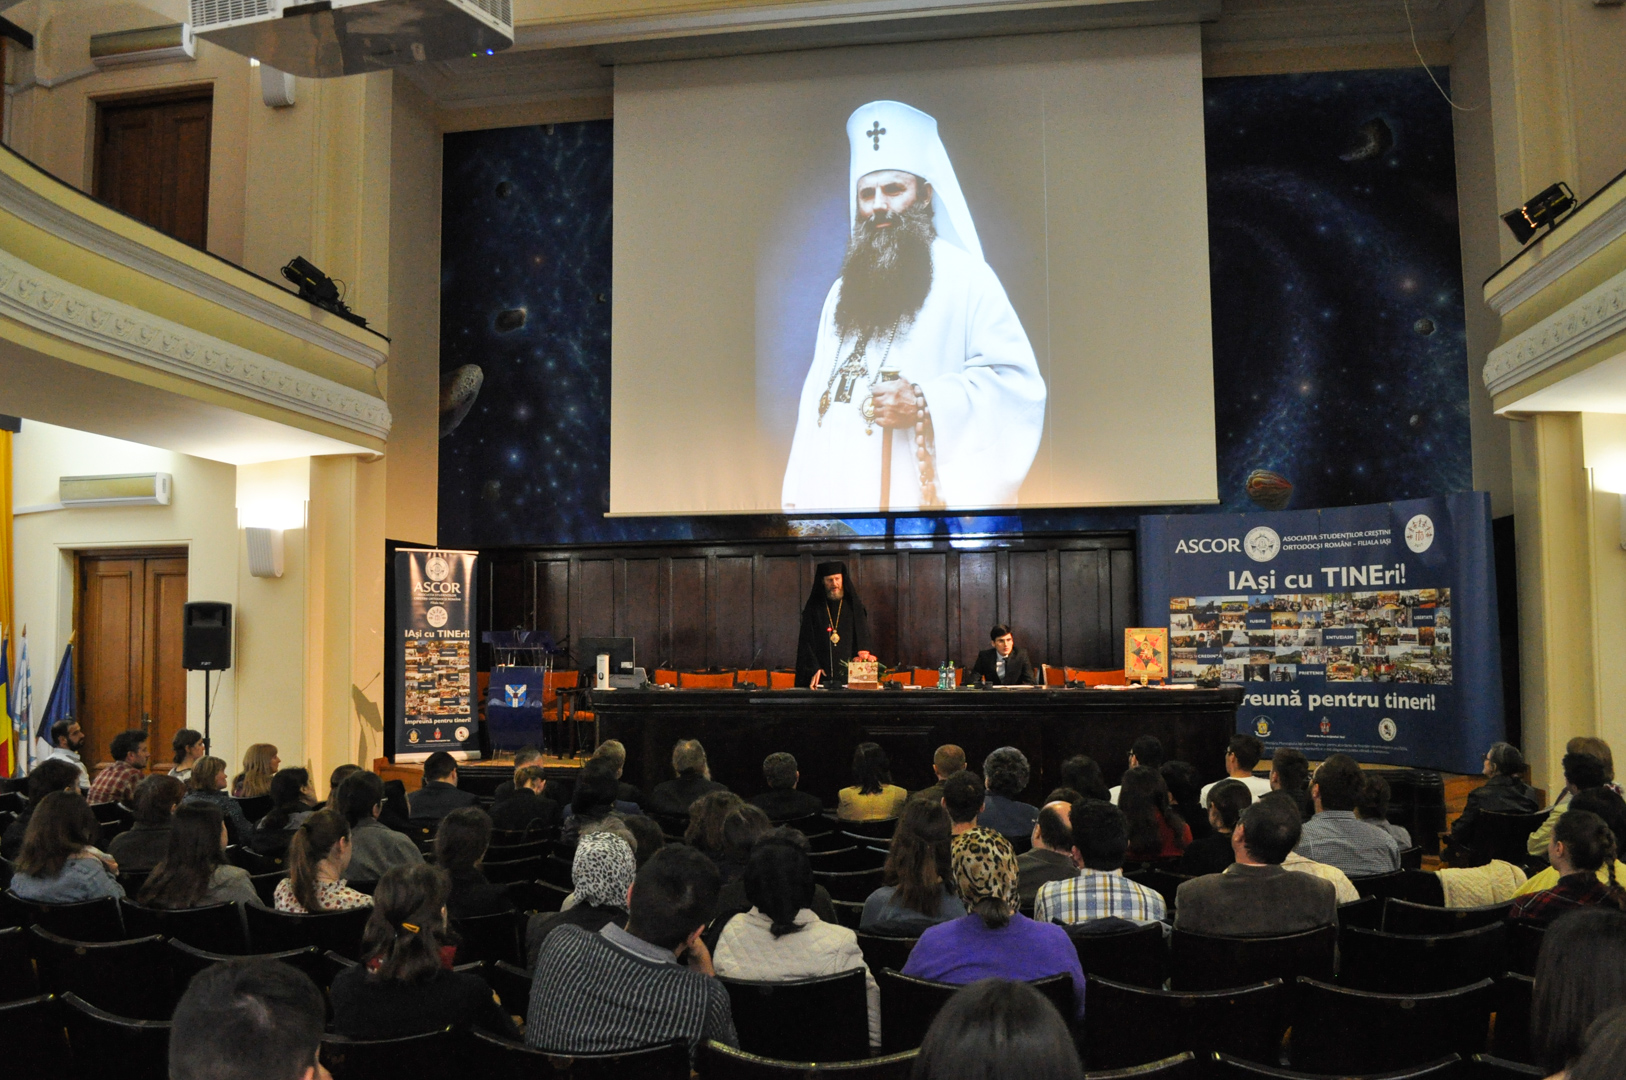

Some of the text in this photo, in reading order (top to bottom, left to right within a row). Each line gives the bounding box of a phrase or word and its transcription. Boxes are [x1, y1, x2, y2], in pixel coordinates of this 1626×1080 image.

[1175, 538, 1241, 553] ASCOR
[1357, 539, 1379, 547] FILIALA
[1284, 573, 1313, 589] cu
[1320, 562, 1406, 588] TINEri!
[413, 581, 461, 593] ASCOR
[437, 629, 470, 638] TINEri!
[1308, 692, 1379, 711] pentru
[1384, 691, 1436, 711] tineri!
